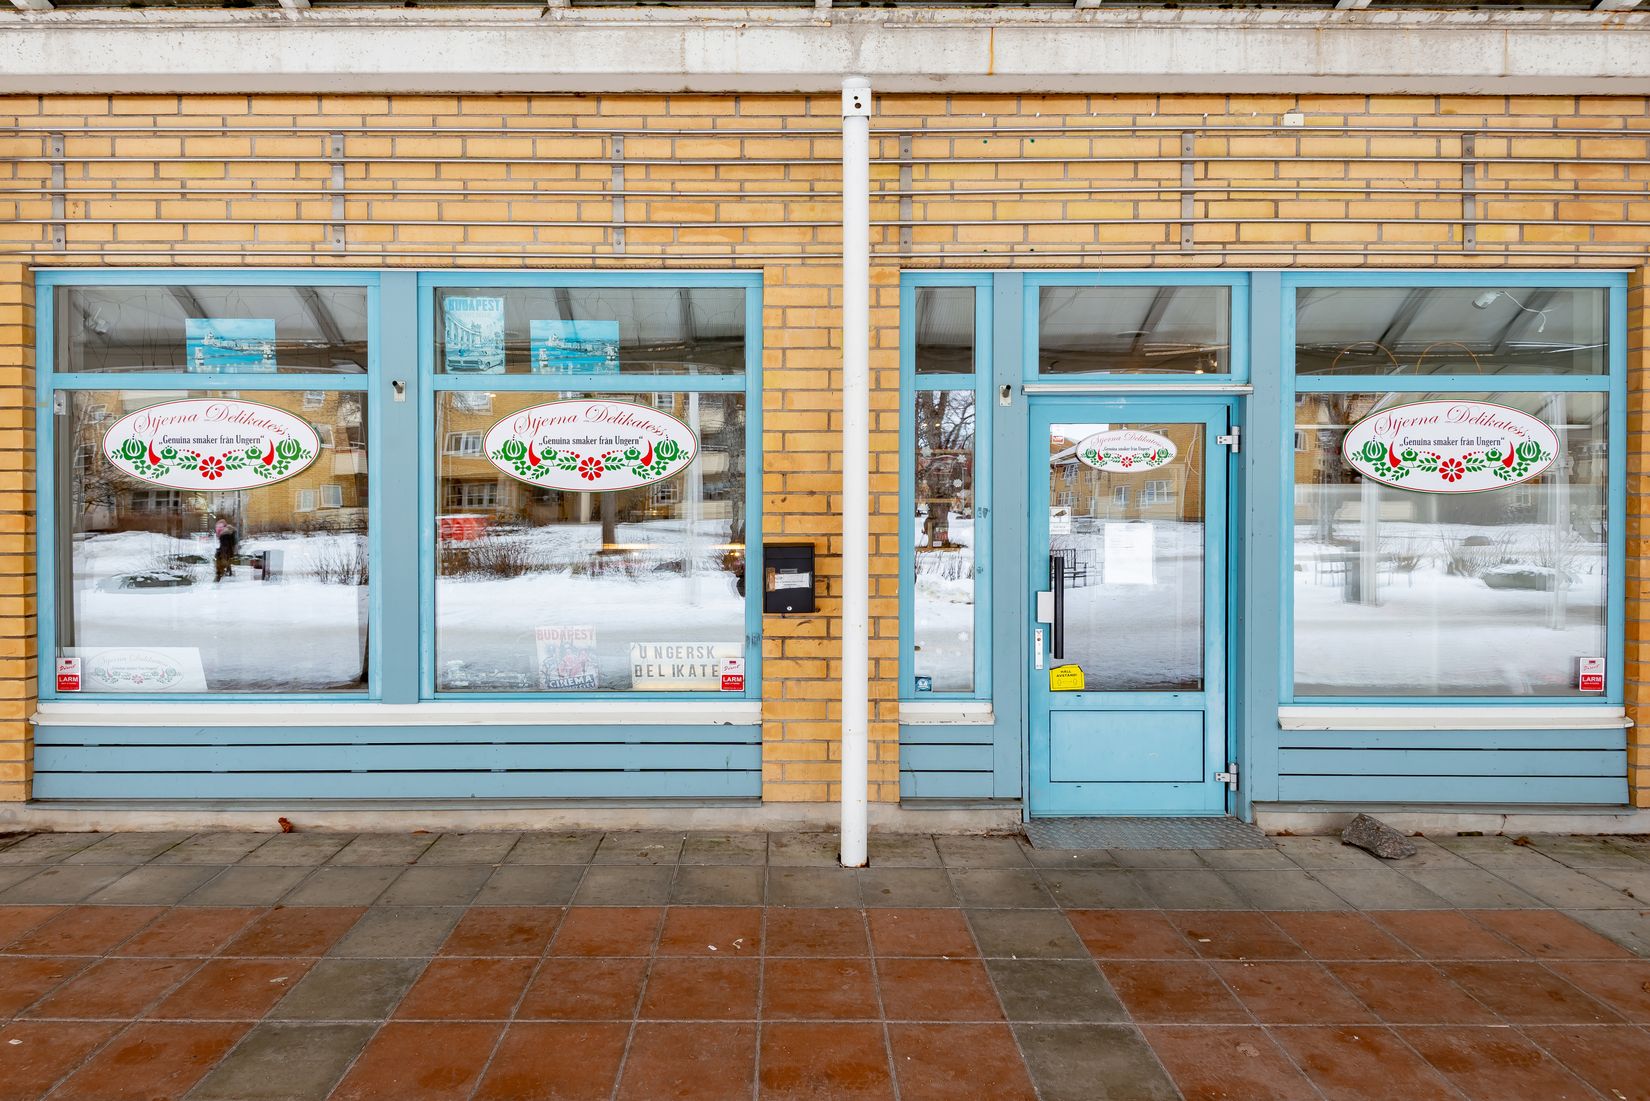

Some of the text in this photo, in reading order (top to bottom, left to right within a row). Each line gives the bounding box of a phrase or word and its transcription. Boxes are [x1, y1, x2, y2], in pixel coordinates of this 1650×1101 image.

[204, 403, 289, 436] Delikatess
[583, 404, 666, 436] Delikatess
[1446, 405, 1528, 438] Delikatess
[192, 434, 218, 444] smaker
[572, 436, 598, 445] smaker
[1433, 436, 1459, 446] smaker
[536, 628, 595, 641] BUDAPEST
[639, 645, 715, 660] UNGERSK
[634, 664, 720, 678] DELIKATE
